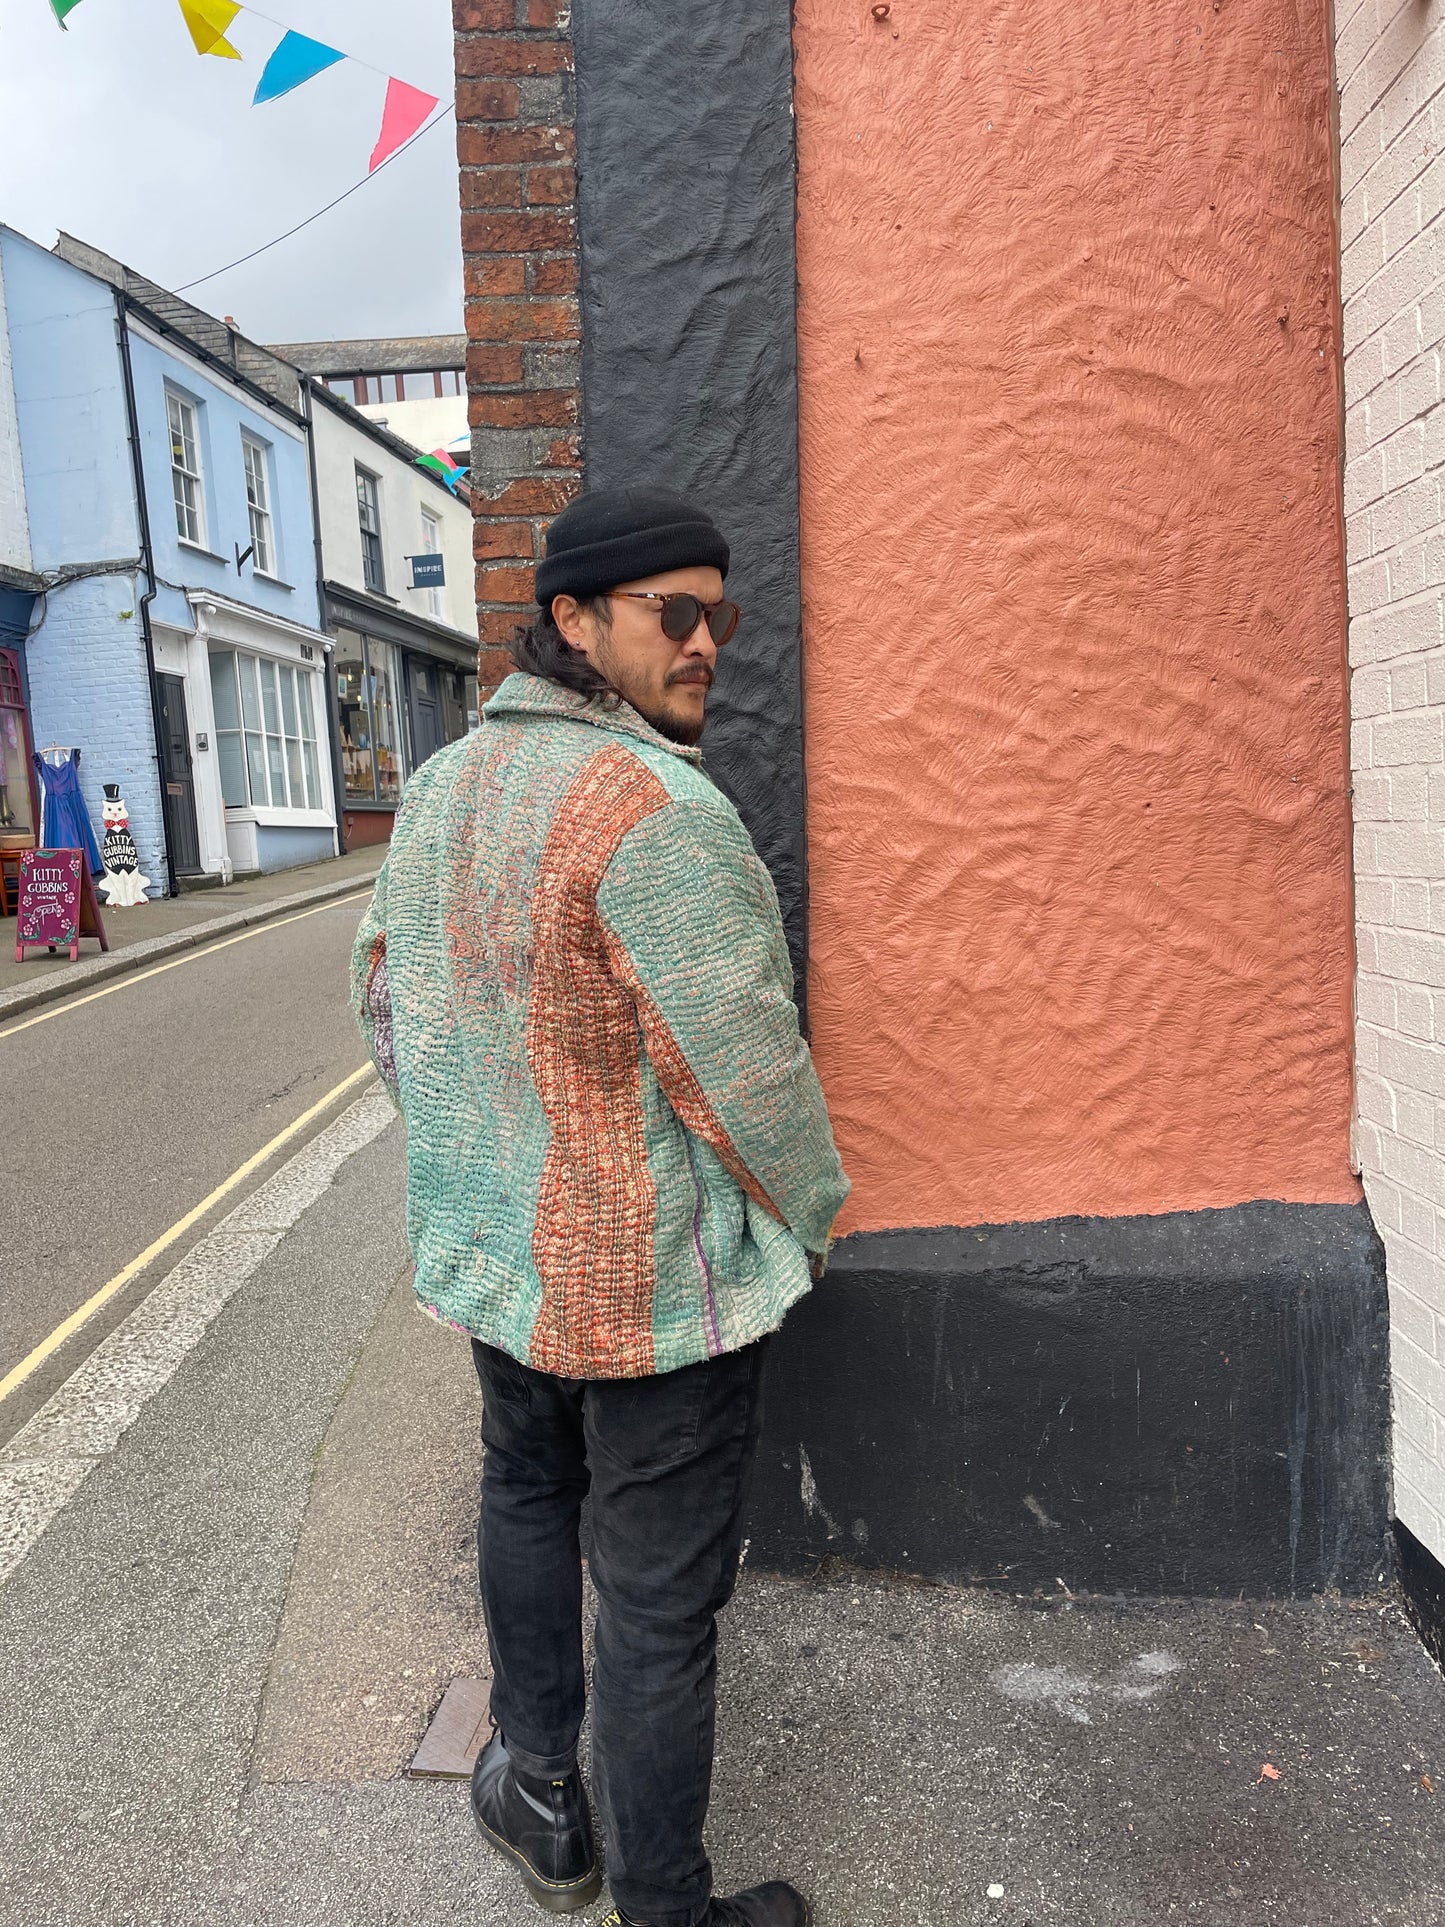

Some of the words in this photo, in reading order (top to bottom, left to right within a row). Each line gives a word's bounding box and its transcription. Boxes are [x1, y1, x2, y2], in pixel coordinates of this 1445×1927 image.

[105, 835, 132, 846] KITTY
[103, 845, 136, 857] GUBBINS
[104, 855, 138, 868] VINTAGE
[32, 868, 64, 881] KITTY
[27, 882, 68, 893] GUBBINS
